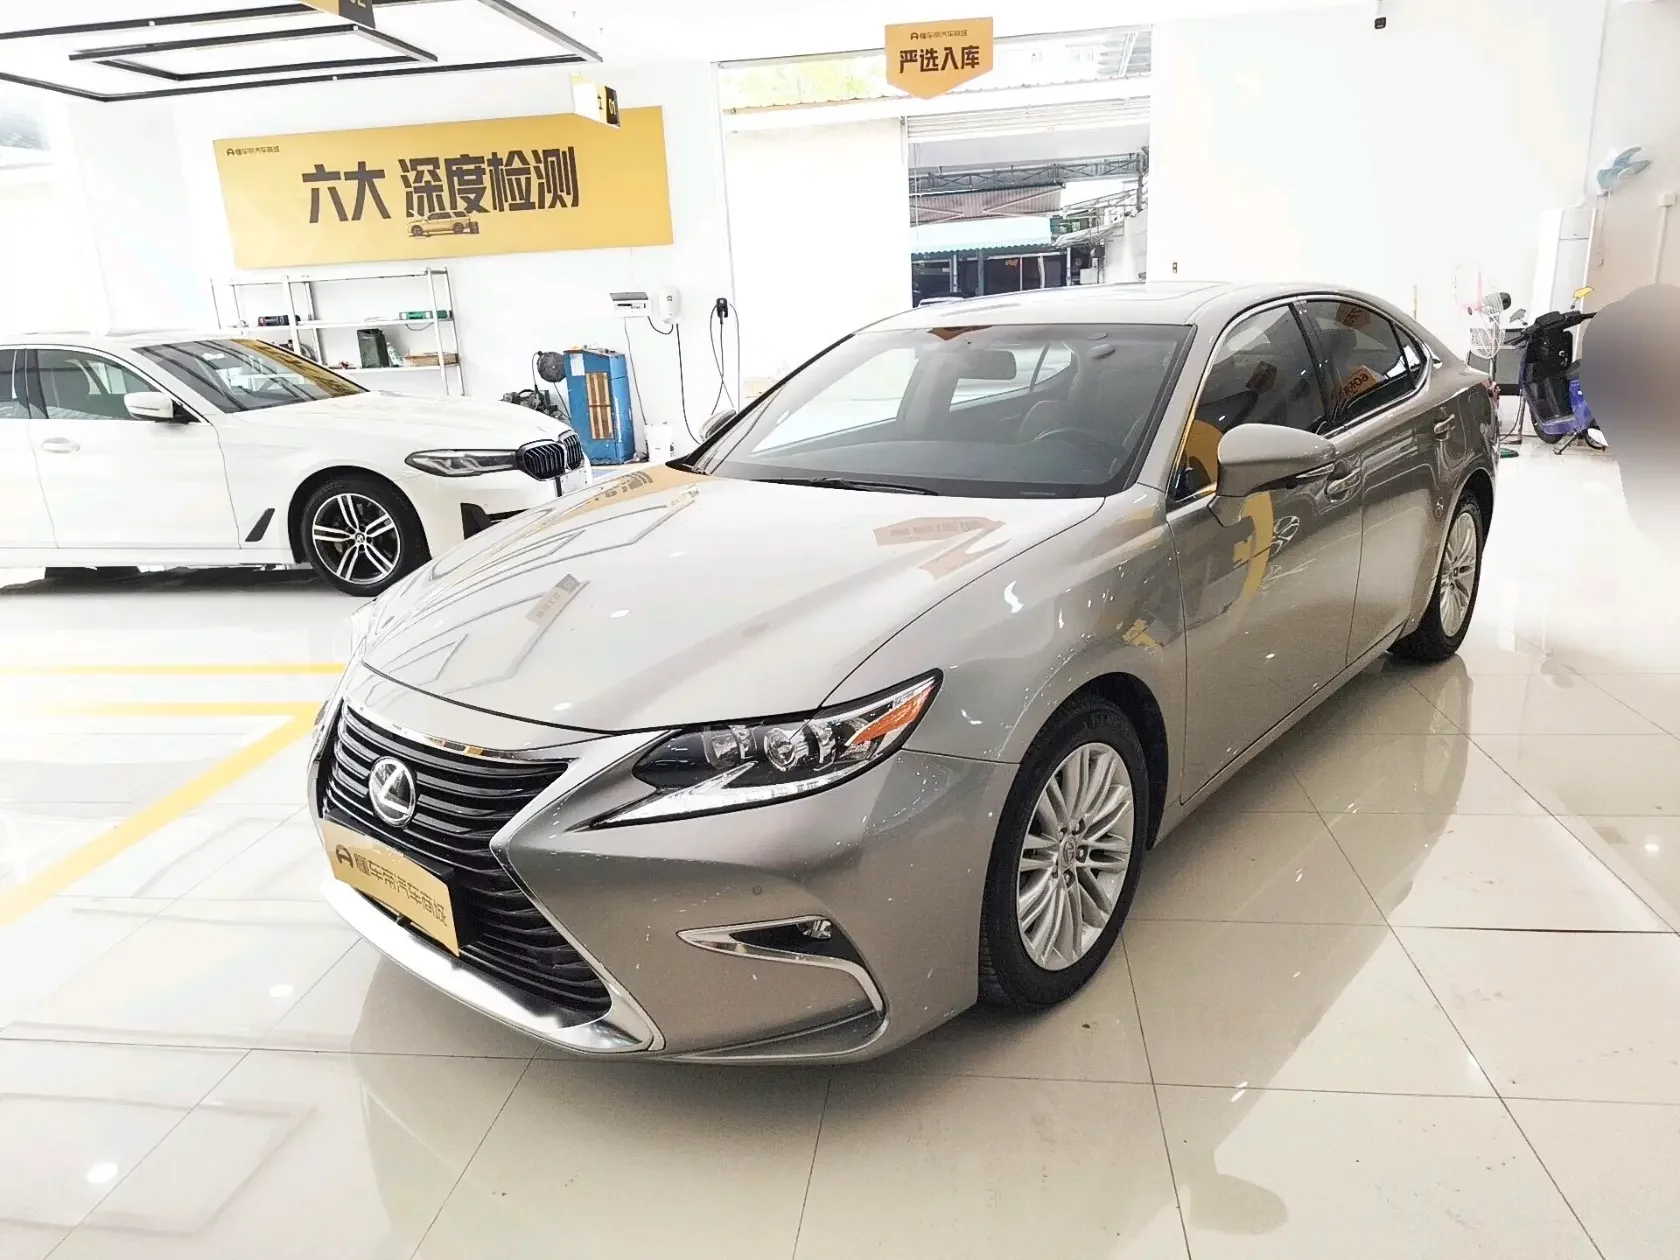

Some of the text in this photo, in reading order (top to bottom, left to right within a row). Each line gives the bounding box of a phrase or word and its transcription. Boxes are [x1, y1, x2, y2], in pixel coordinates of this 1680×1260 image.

[899, 44, 980, 74] 严选入库
[301, 145, 580, 224] 六大 深度检测
[353, 852, 448, 928] 懂车帝汽车商城
